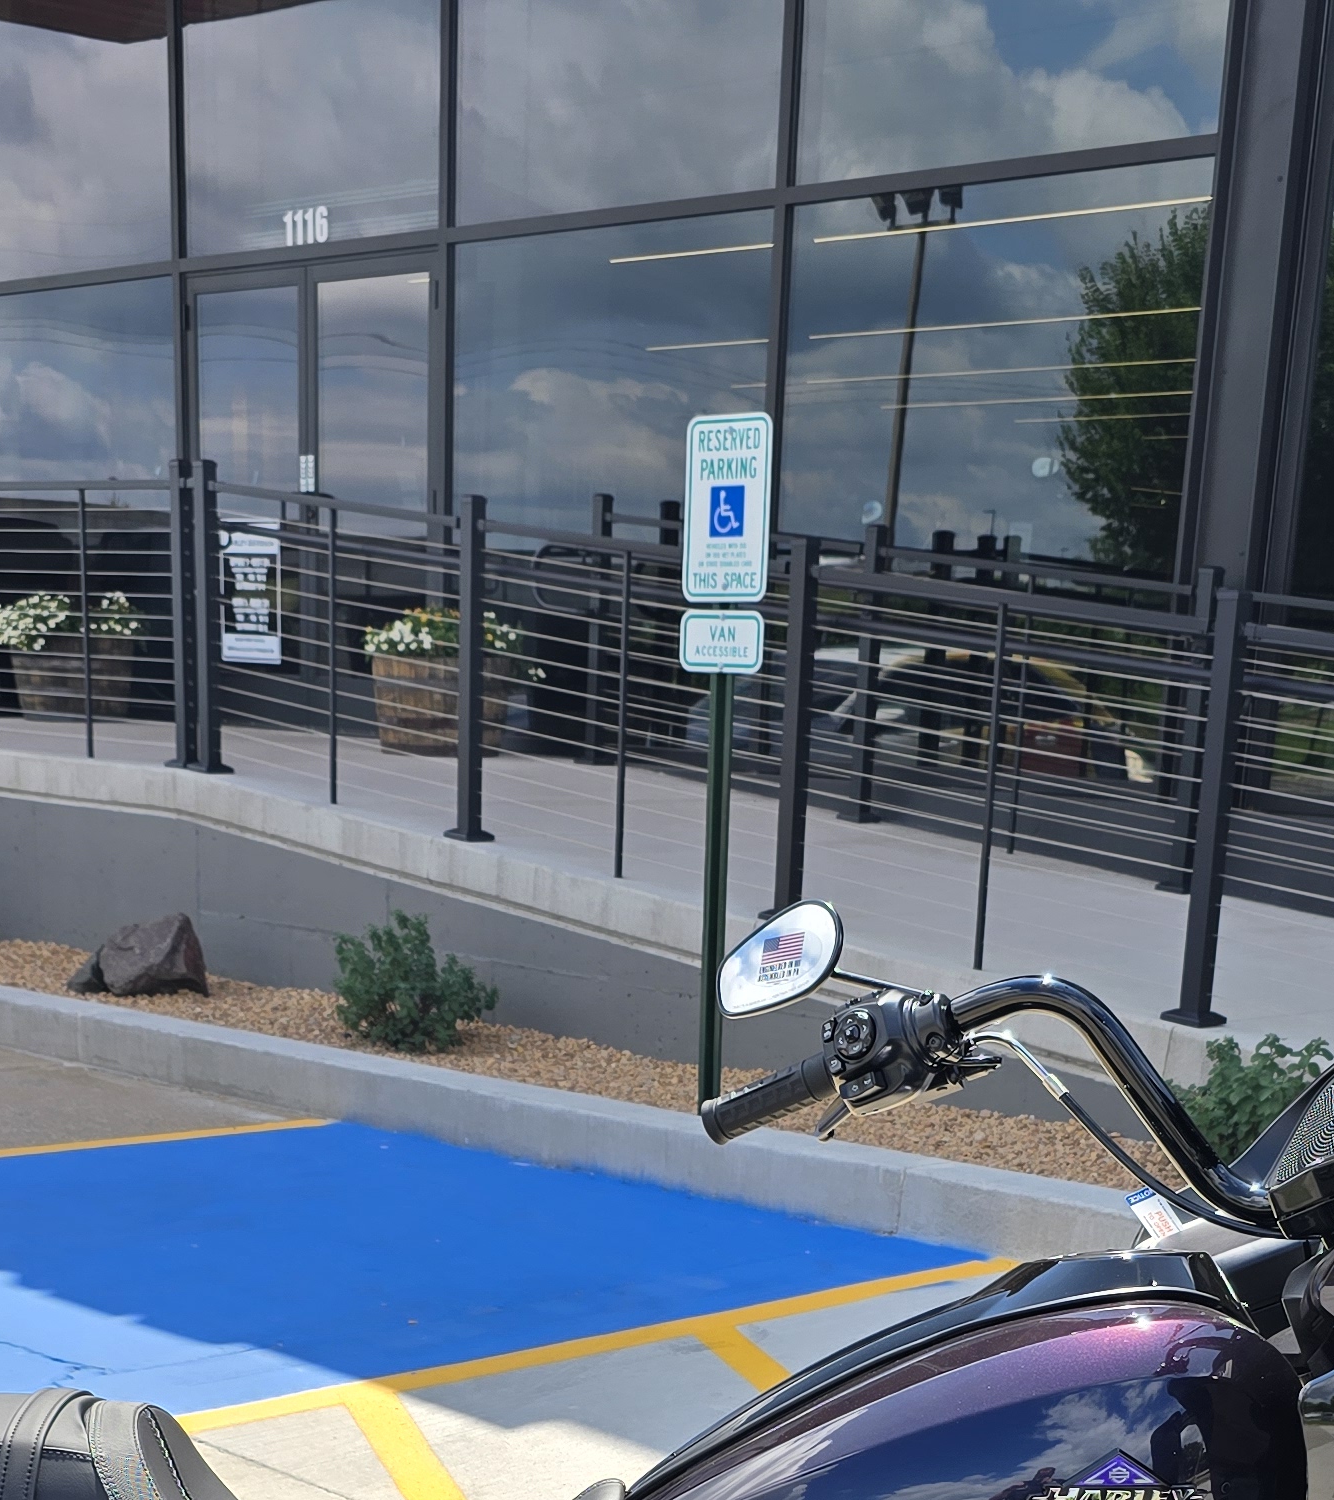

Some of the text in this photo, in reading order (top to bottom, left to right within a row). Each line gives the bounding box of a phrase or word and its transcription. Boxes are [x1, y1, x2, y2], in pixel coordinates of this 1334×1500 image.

[282, 205, 329, 247] 1116
[698, 426, 761, 453] RESERVED
[700, 456, 757, 481] PARKING
[692, 571, 757, 591] THIS SPACE
[709, 625, 736, 643] VAN
[694, 645, 749, 658] ACCESSIBLE
[1154, 1210, 1174, 1232] PUSH
